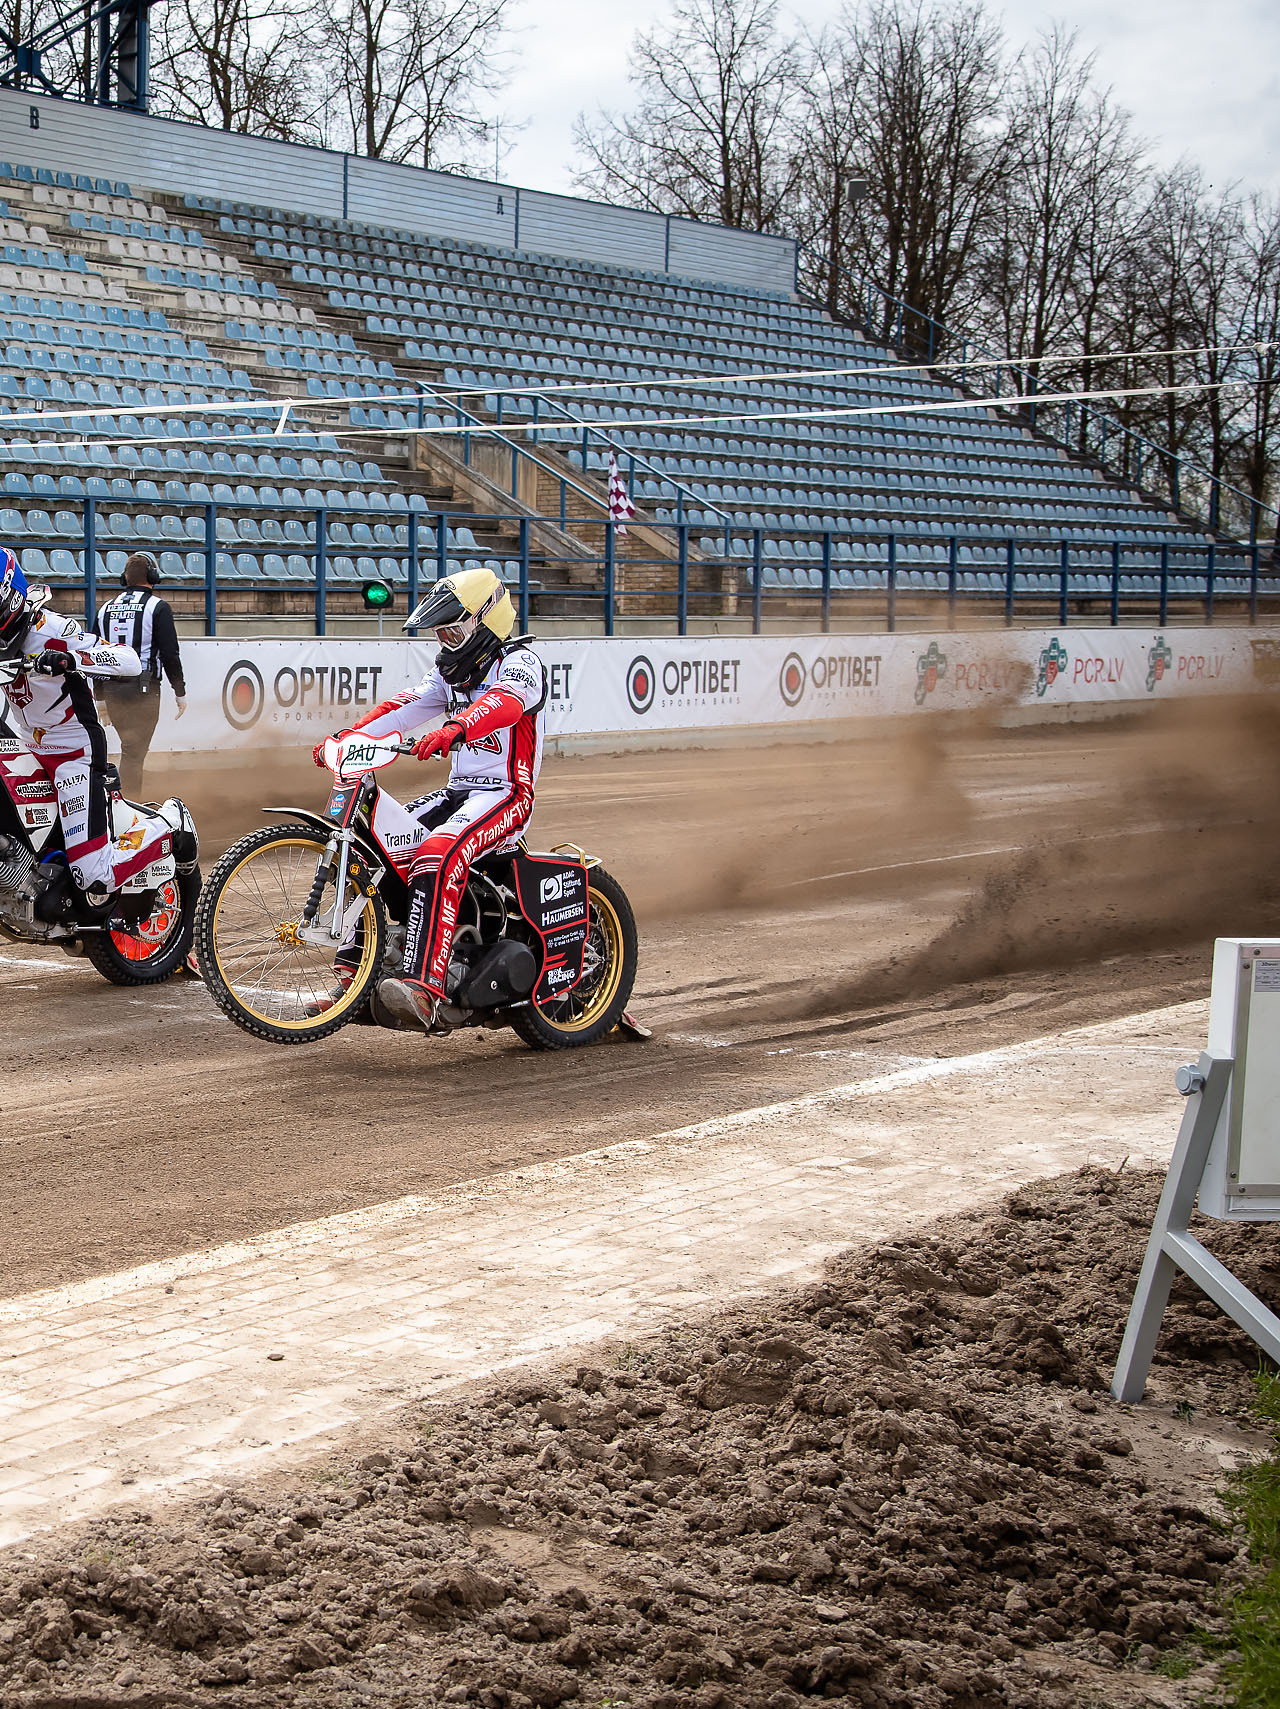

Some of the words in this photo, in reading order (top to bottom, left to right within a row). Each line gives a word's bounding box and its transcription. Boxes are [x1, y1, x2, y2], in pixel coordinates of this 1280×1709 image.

[29, 105, 40, 130] B
[496, 195, 504, 216] A
[662, 659, 741, 696] OPTIBET
[810, 655, 883, 689] OPTIBET
[1073, 657, 1125, 684] PCR.LV
[1177, 654, 1225, 681] PCR.LV
[273, 666, 383, 708] OPTIBET
[273, 711, 333, 722] SPORTA
[346, 744, 377, 762] BAU
[384, 832, 411, 848] Trans
[563, 887, 576, 898] Sport
[441, 898, 457, 927] MF
[541, 905, 584, 927] HAUMERSEN
[403, 888, 426, 973] HAUMERSEN
[433, 928, 453, 973] Trans
